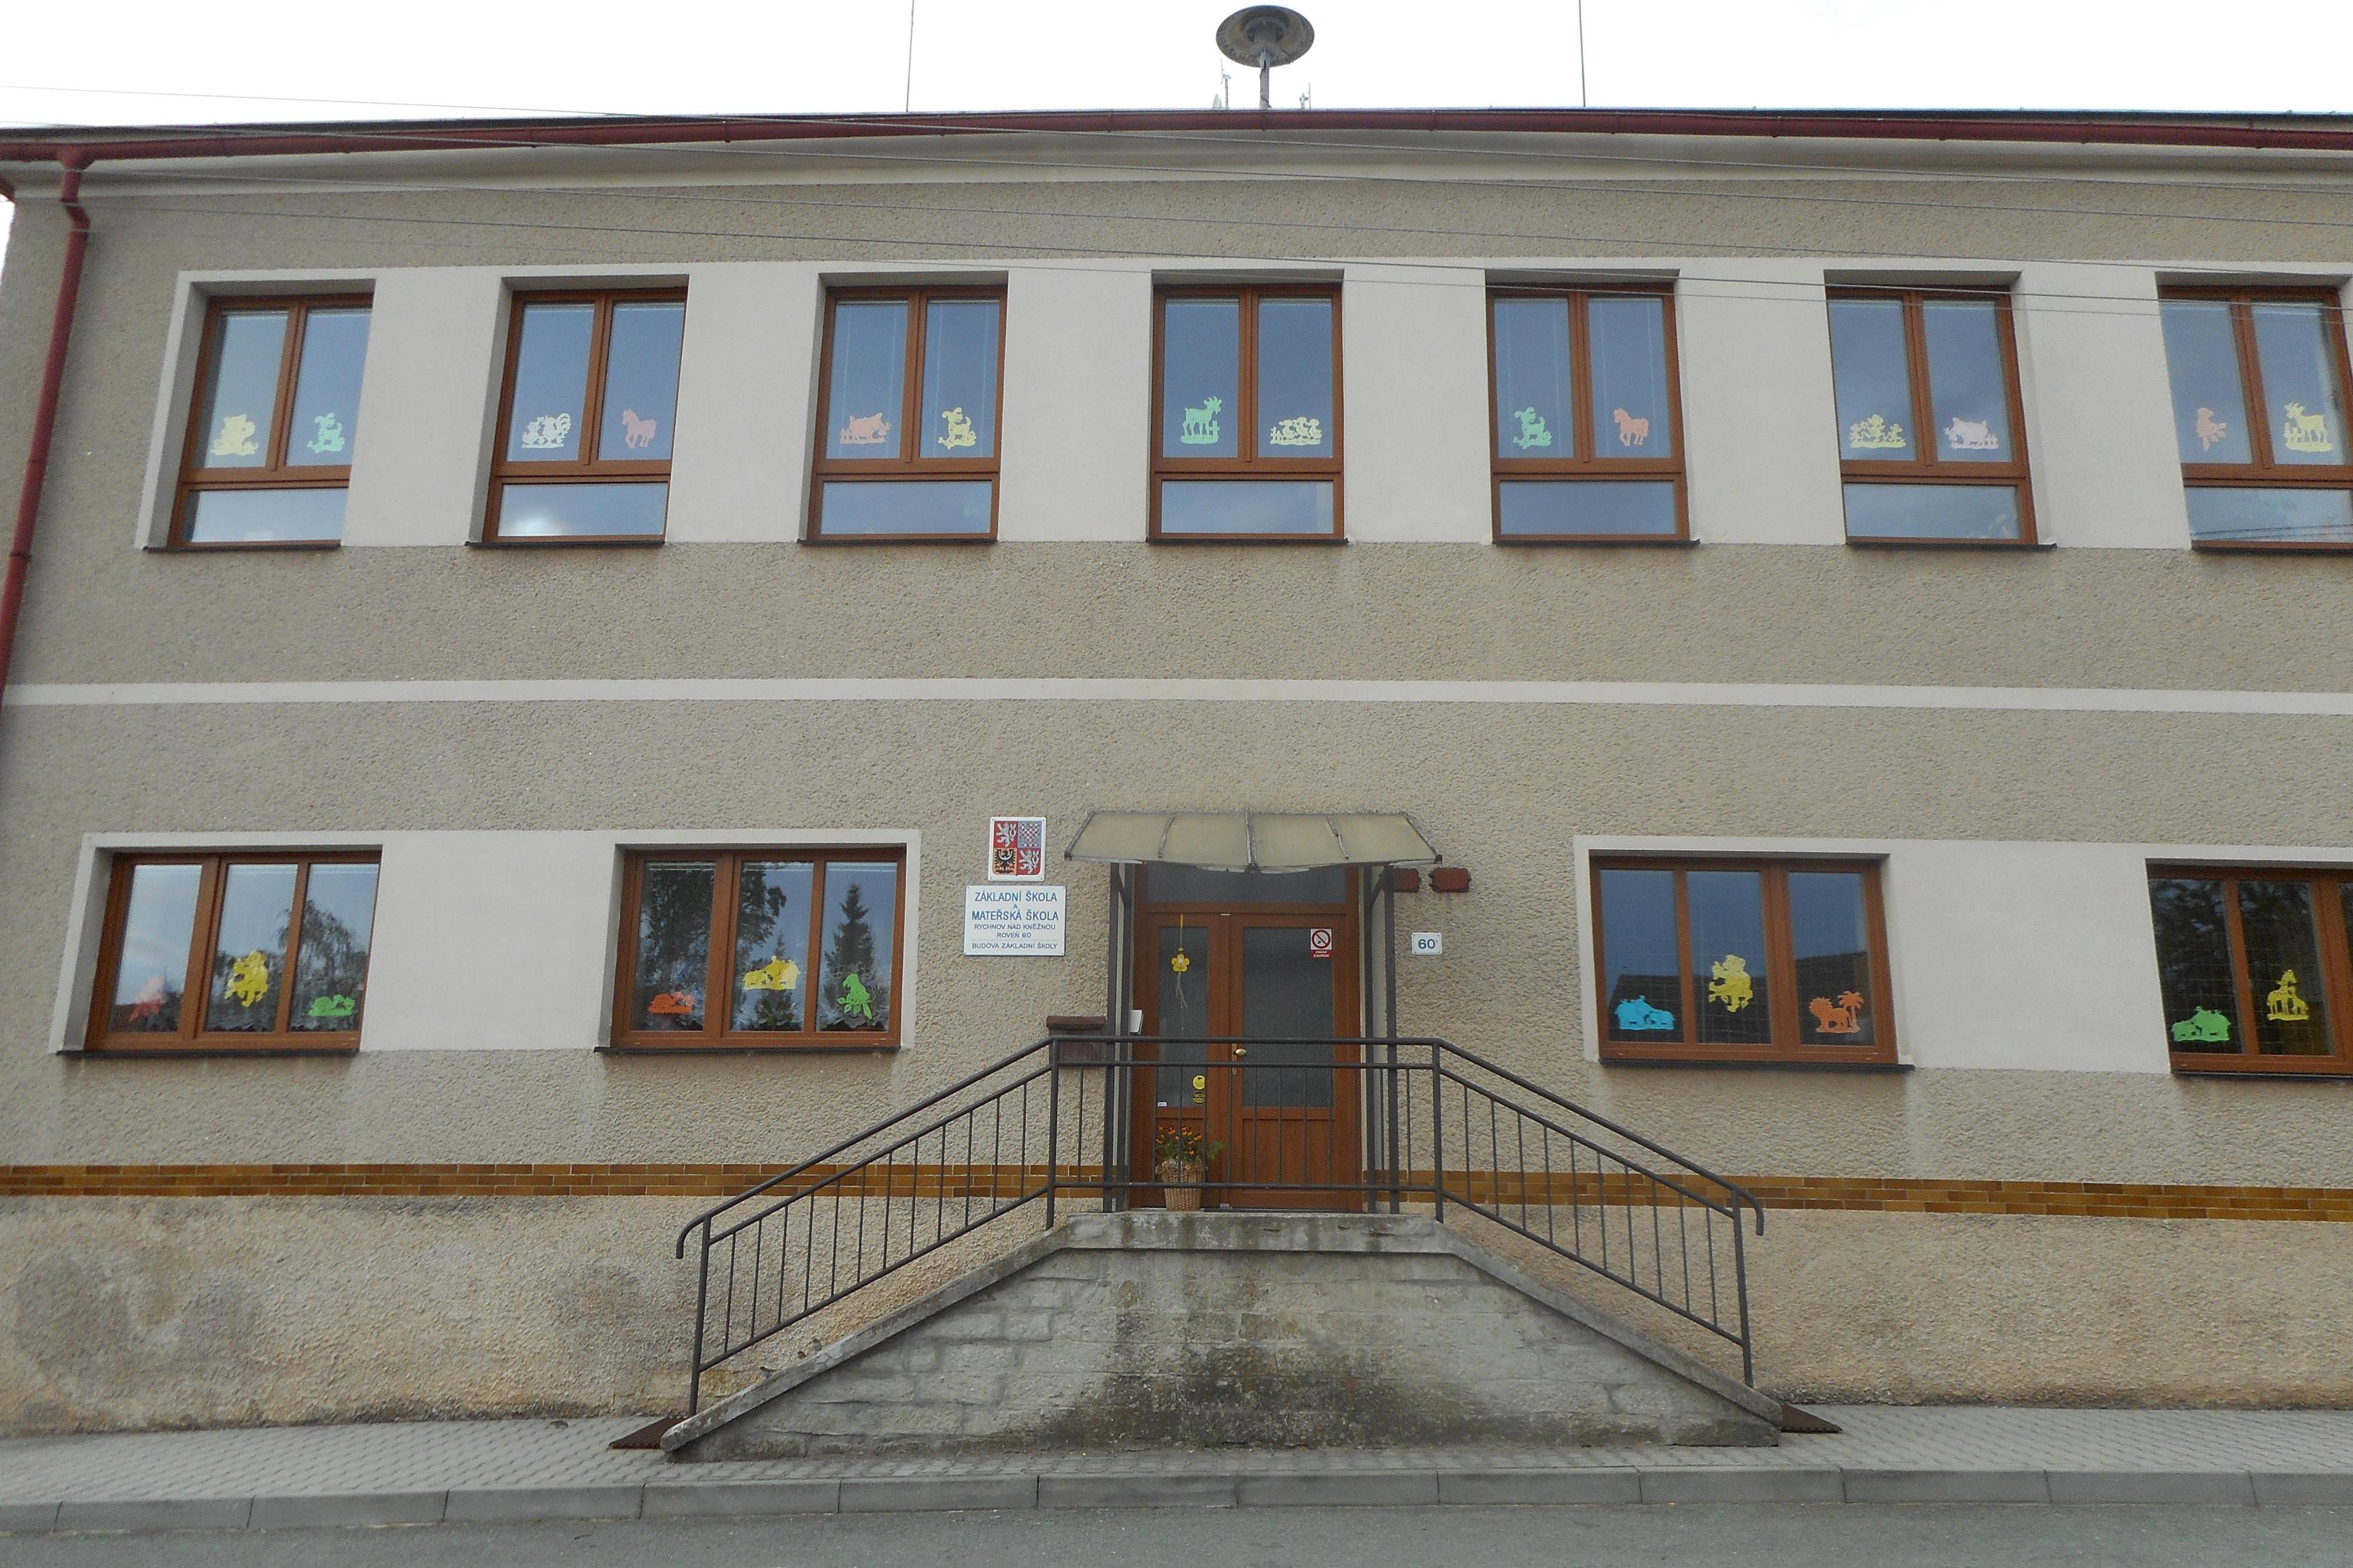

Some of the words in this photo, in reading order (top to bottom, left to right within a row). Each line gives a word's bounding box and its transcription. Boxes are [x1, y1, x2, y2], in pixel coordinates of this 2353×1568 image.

[974, 890, 1022, 902] ZÁKLADNÍ
[1025, 890, 1058, 902] ŠKOLA
[972, 909, 1022, 920] MATEŘSKÁ
[1025, 909, 1059, 921] ŠKOLA
[1418, 939, 1436, 949] 60
